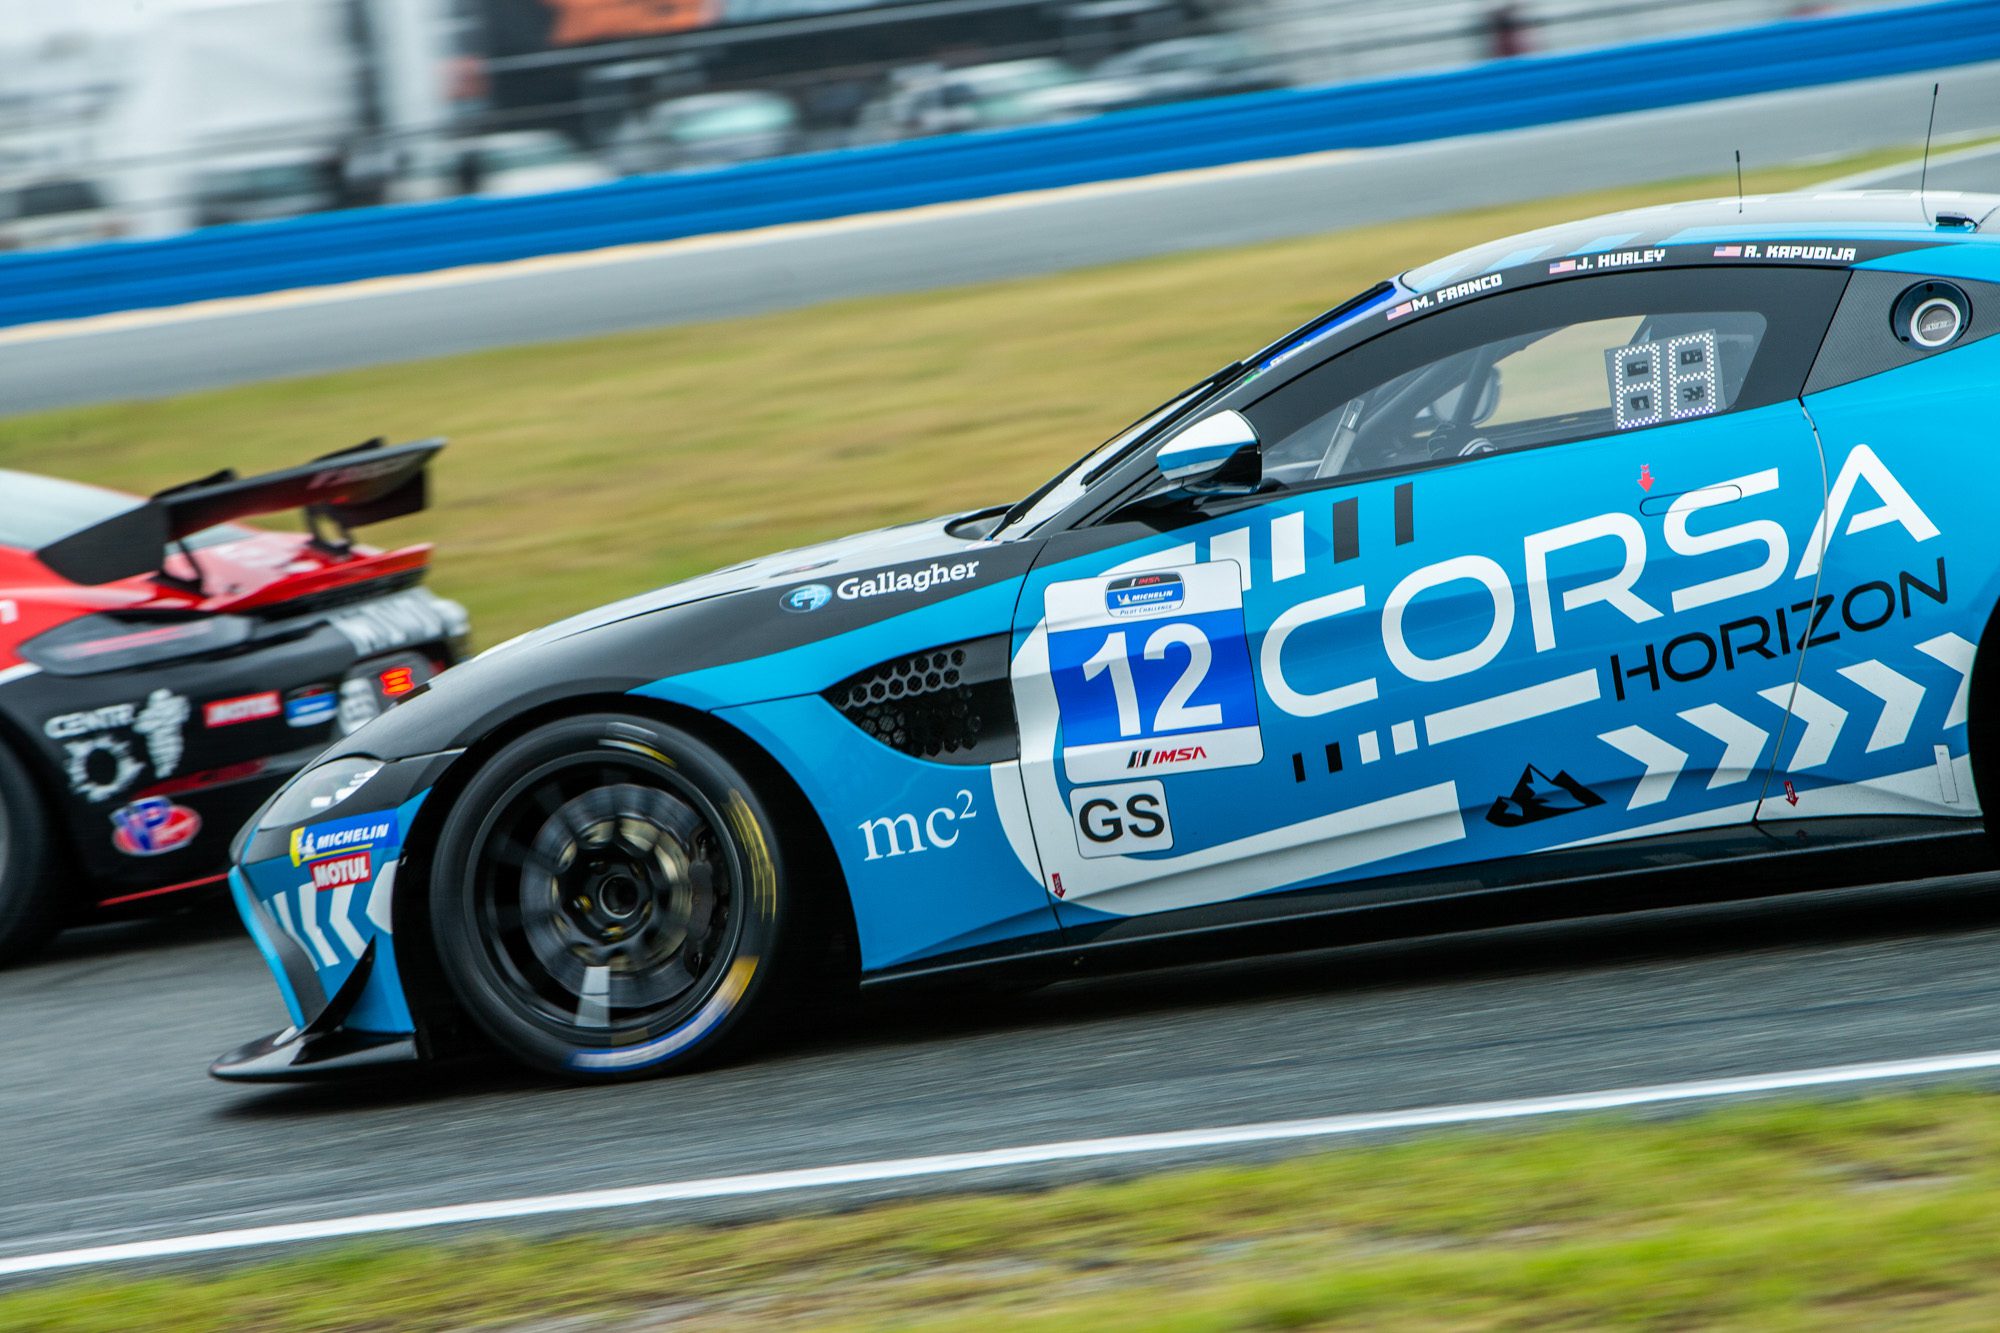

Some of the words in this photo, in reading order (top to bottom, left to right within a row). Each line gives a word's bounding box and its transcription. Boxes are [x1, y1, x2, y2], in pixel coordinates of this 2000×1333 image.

[1577, 256, 1594, 271] J.
[1598, 249, 1666, 269] HURLEY
[1744, 245, 1761, 258] R.
[1766, 245, 1857, 261] KAPUDIJA
[1412, 295, 1435, 312] M.
[1437, 273, 1503, 304] FRANCO
[836, 561, 980, 600] Gallagher
[1131, 590, 1174, 601] MICHELIN
[1260, 443, 1941, 717] CORSA
[1610, 557, 1948, 702] HORIZON
[1082, 622, 1223, 737] 12
[1152, 745, 1208, 765] IMSA
[316, 822, 390, 850] MICHELIN
[1079, 794, 1166, 843] GS
[313, 856, 370, 888] MOTUL
